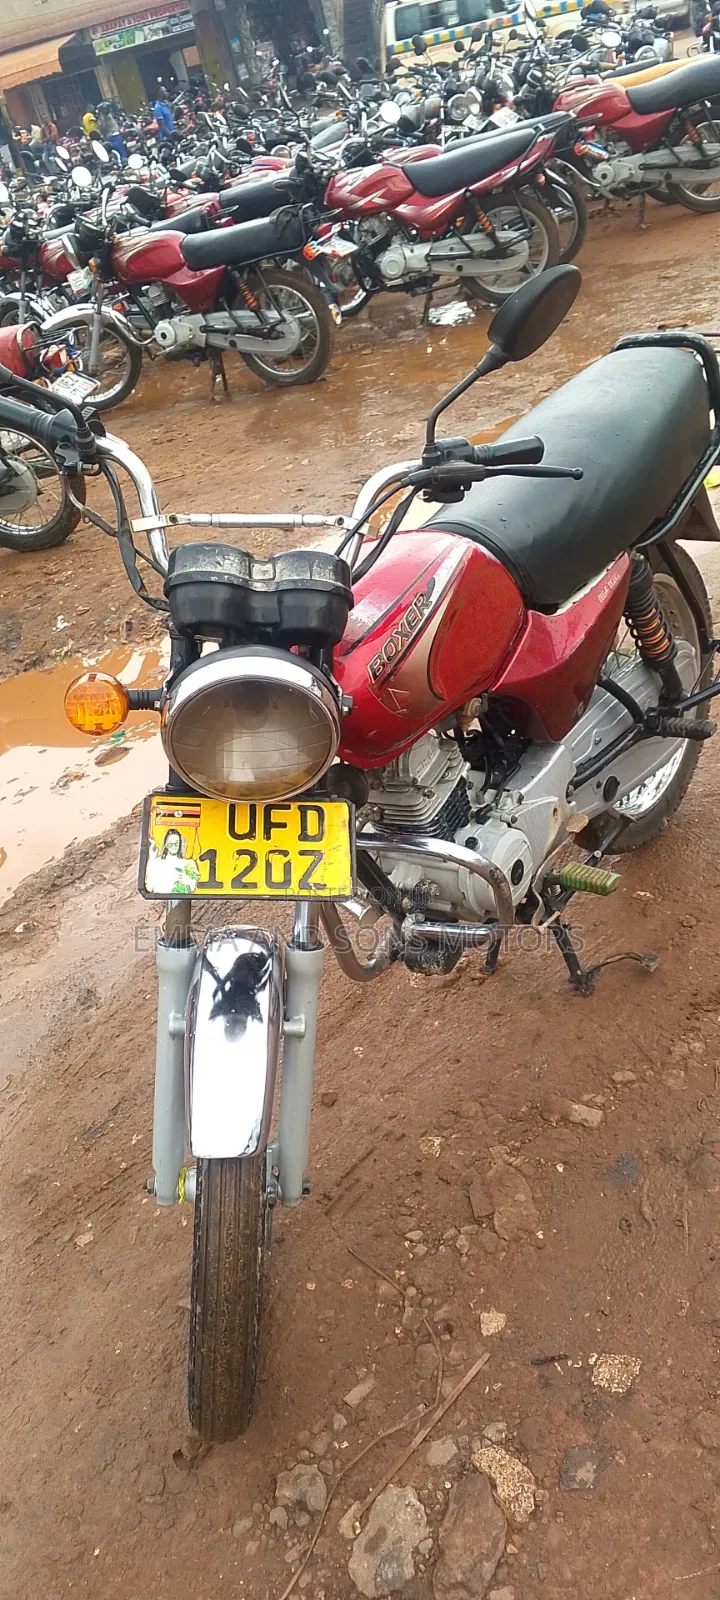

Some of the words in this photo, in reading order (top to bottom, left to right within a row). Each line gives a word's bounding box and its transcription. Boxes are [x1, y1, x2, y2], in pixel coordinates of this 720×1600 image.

[367, 592, 433, 685] BOXER
[228, 803, 325, 842] UFD
[197, 849, 327, 890] 120Z
